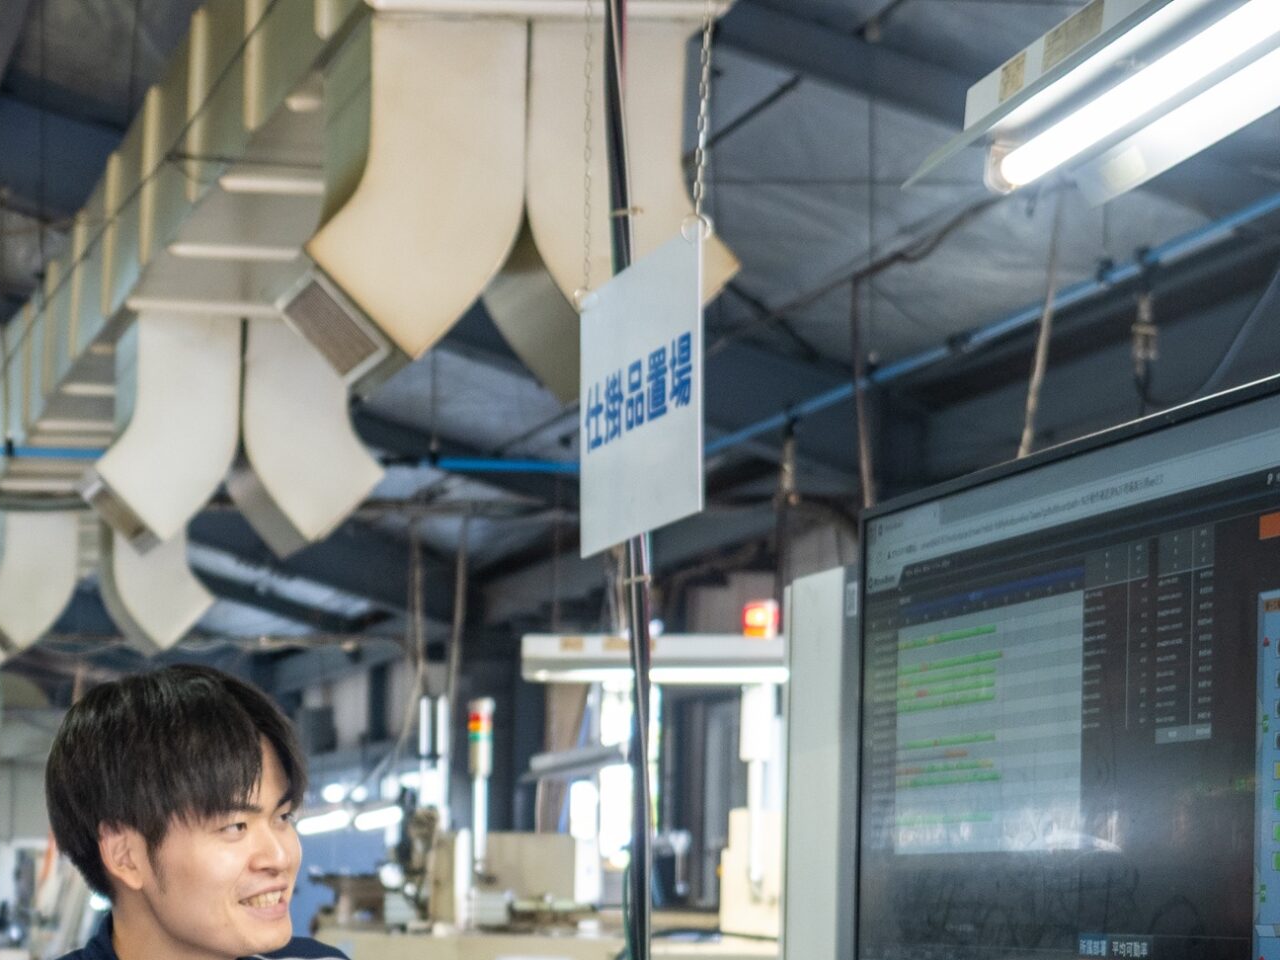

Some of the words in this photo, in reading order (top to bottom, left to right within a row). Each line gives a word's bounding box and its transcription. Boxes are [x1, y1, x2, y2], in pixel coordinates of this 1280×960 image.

[585, 331, 692, 454] 仕掛品置場
